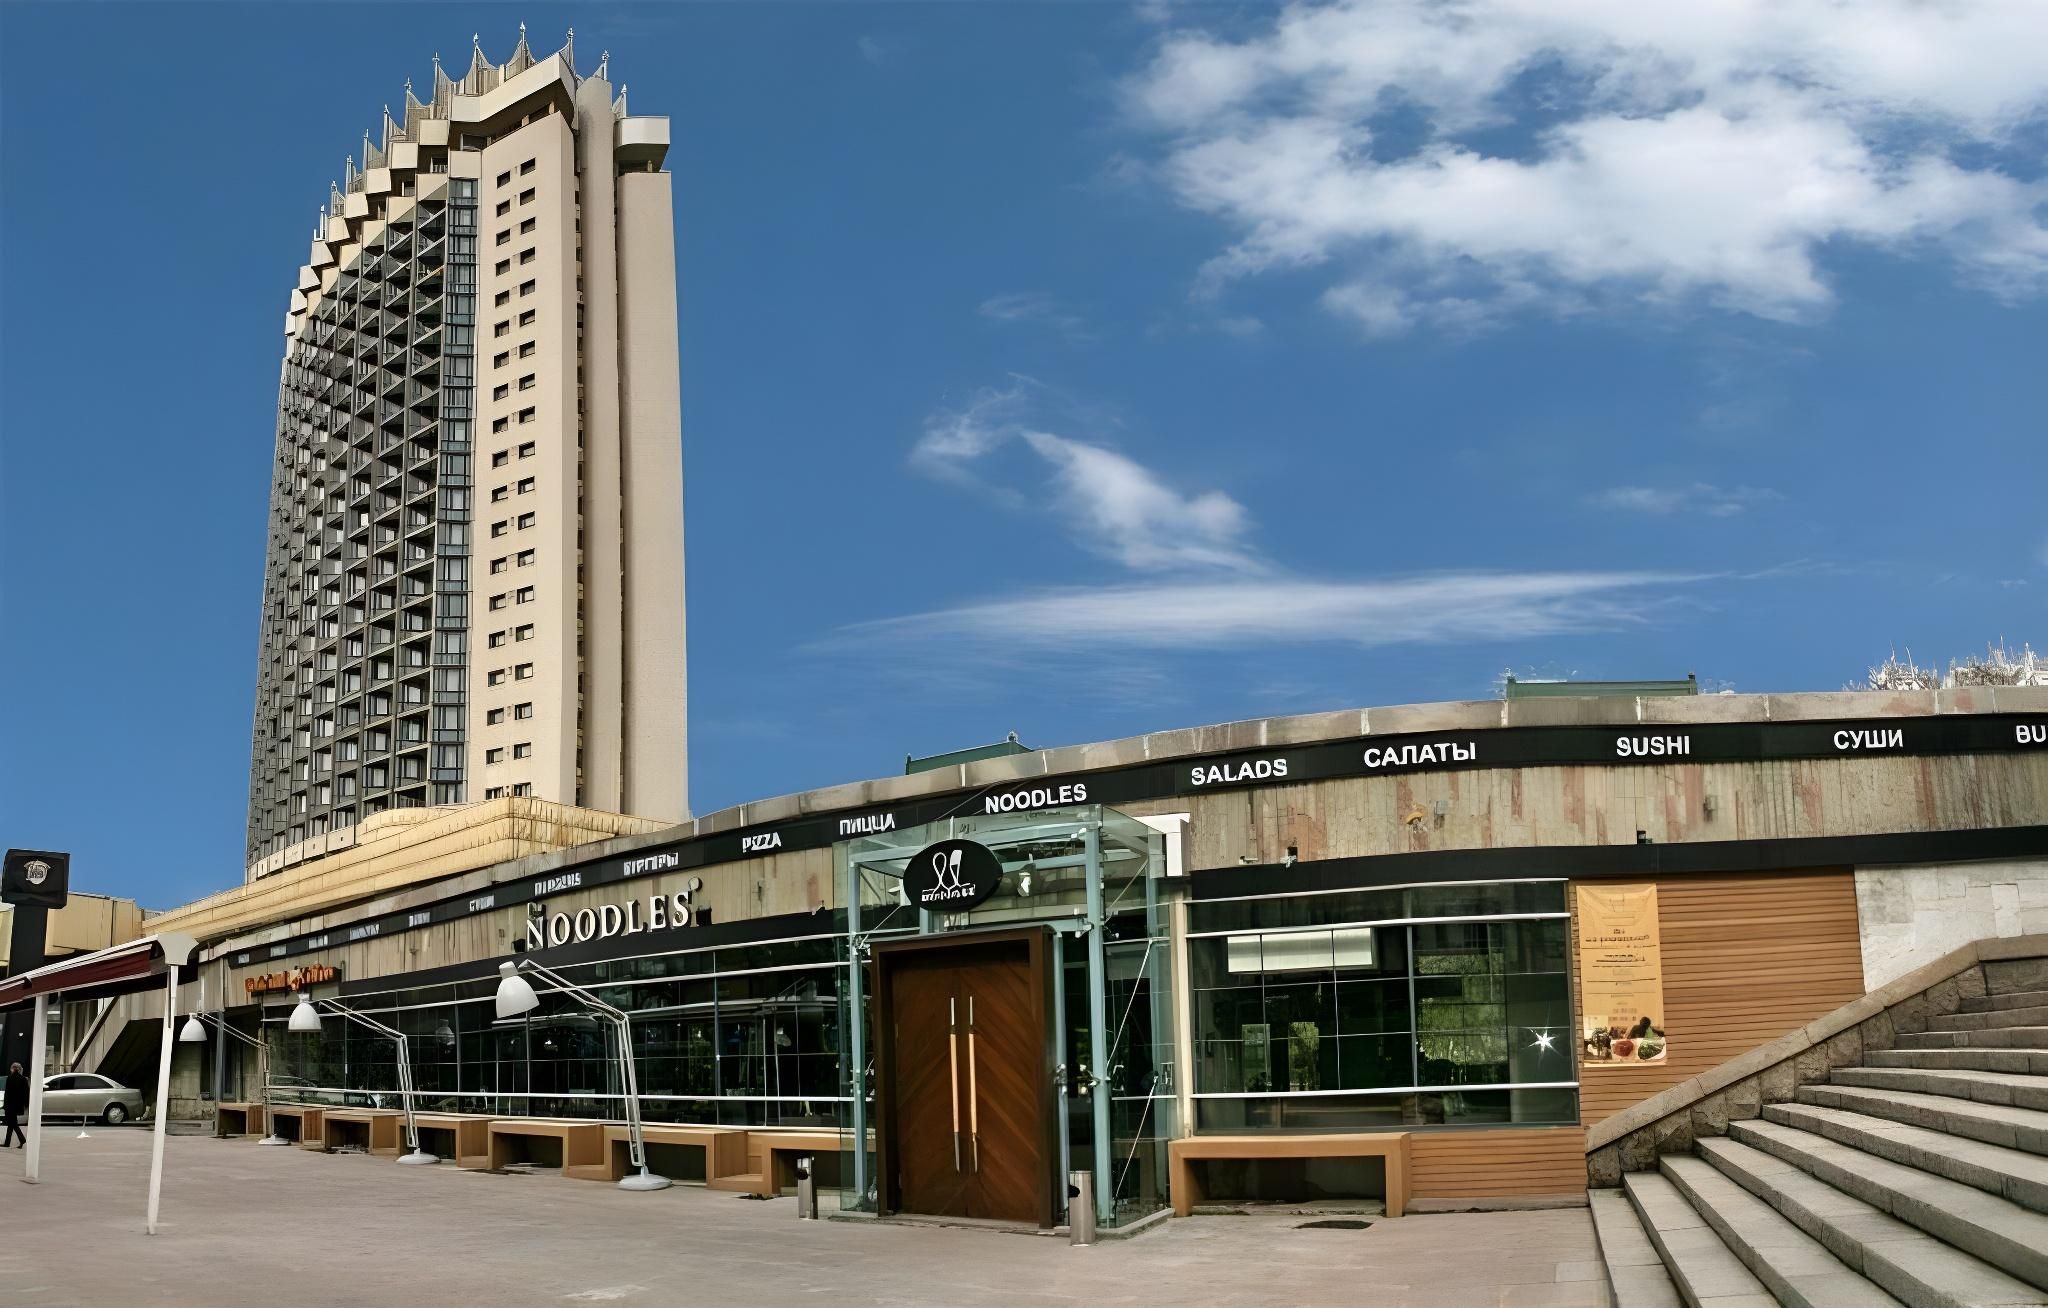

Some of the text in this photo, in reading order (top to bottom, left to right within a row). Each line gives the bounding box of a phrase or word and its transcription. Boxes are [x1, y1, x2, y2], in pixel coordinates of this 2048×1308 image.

[1616, 735, 1690, 757] SUSHI
[1833, 729, 1904, 750] СУШИ
[2016, 725, 2046, 743] BU
[1364, 742, 1476, 768] САЛАТЫ
[1191, 758, 1288, 785] SALADS
[985, 783, 1087, 814] NOODLES
[839, 813, 896, 835] ПИЦЦА
[527, 890, 691, 950] NOODLES
